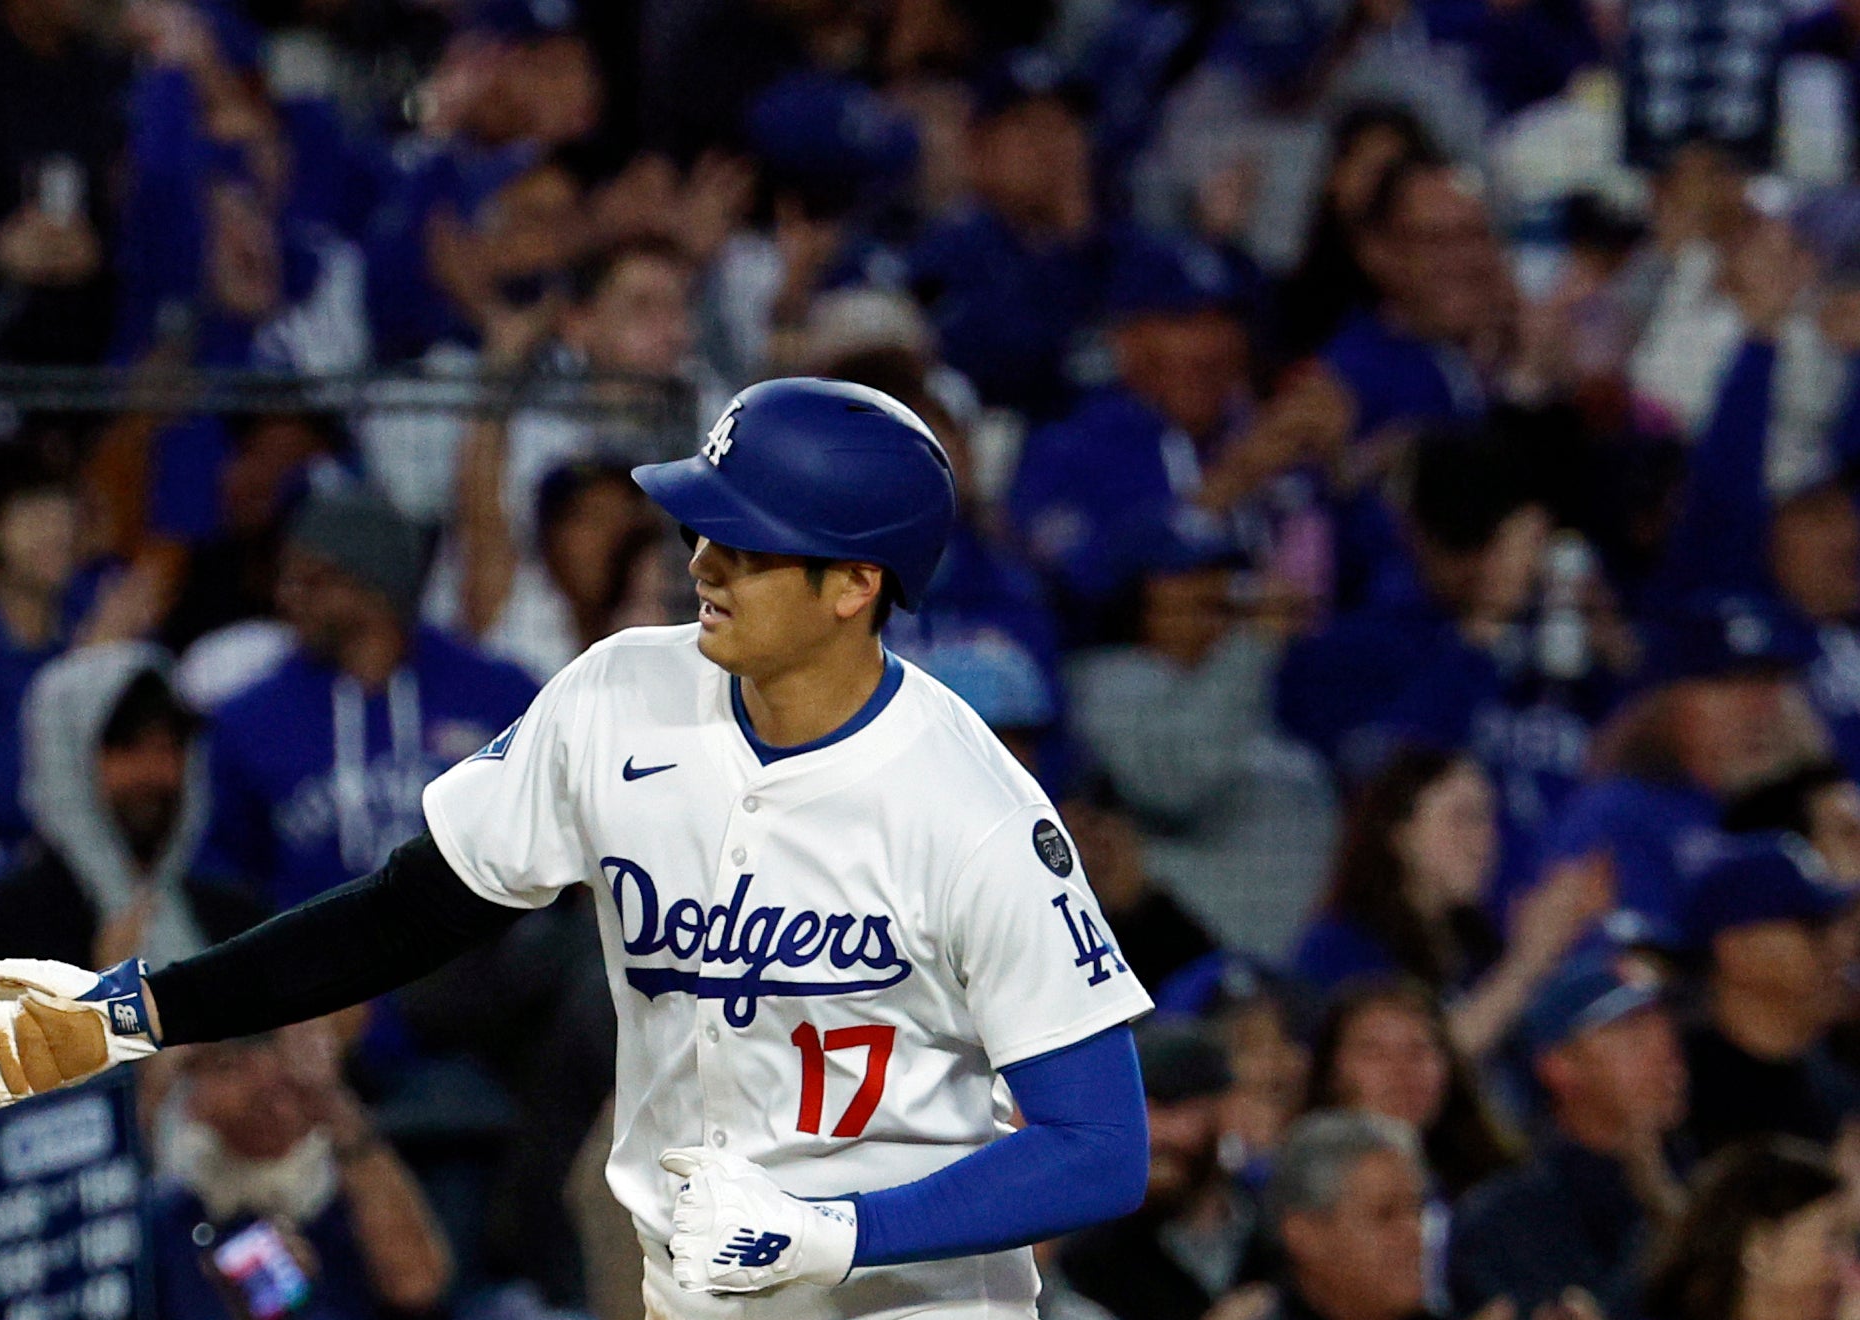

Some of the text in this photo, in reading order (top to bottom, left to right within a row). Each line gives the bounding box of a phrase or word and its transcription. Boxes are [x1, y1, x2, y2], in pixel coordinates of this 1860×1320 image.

[701, 398, 742, 466] LA
[601, 856, 912, 1028] Dodgers
[1051, 892, 1127, 987] LA
[791, 1021, 896, 1138] 17
